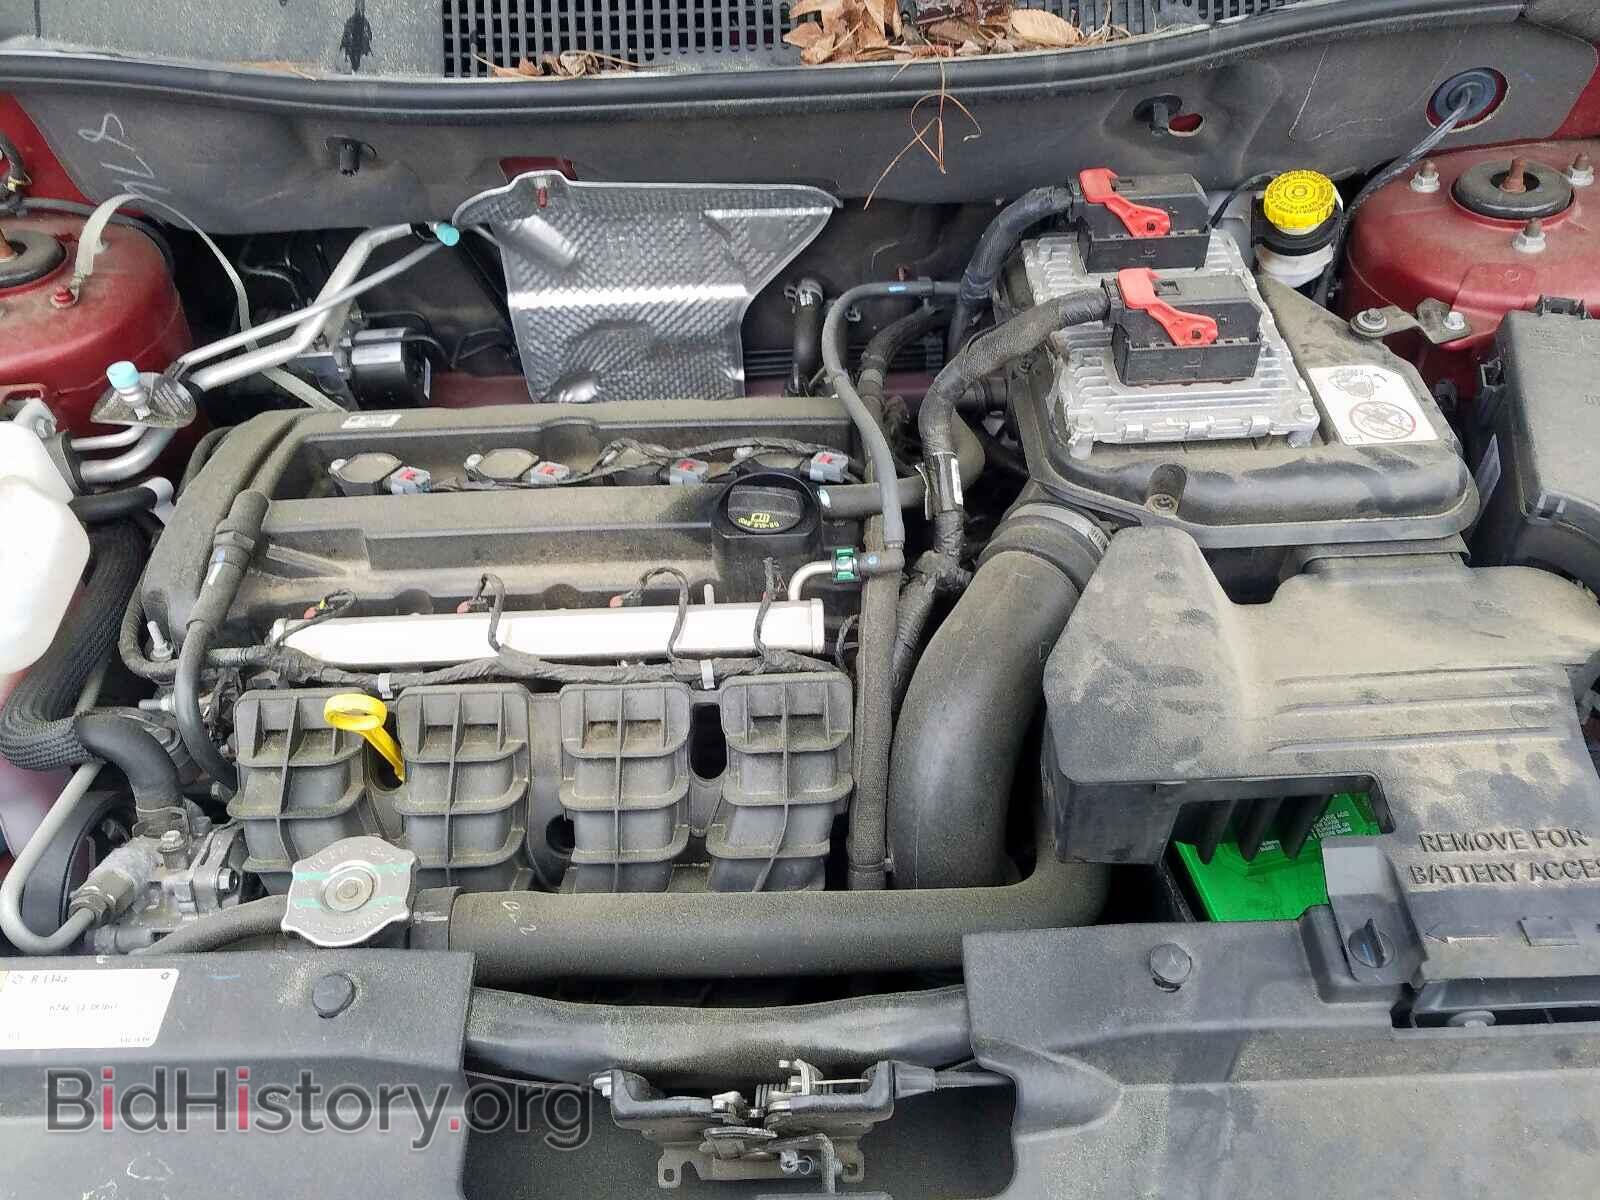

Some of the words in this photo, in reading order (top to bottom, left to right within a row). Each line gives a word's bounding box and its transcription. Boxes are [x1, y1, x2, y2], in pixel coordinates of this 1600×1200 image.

[1419, 830, 1529, 853] REMOVE
[1531, 828, 1590, 849] FOR
[1409, 862, 1518, 885] BATTERY
